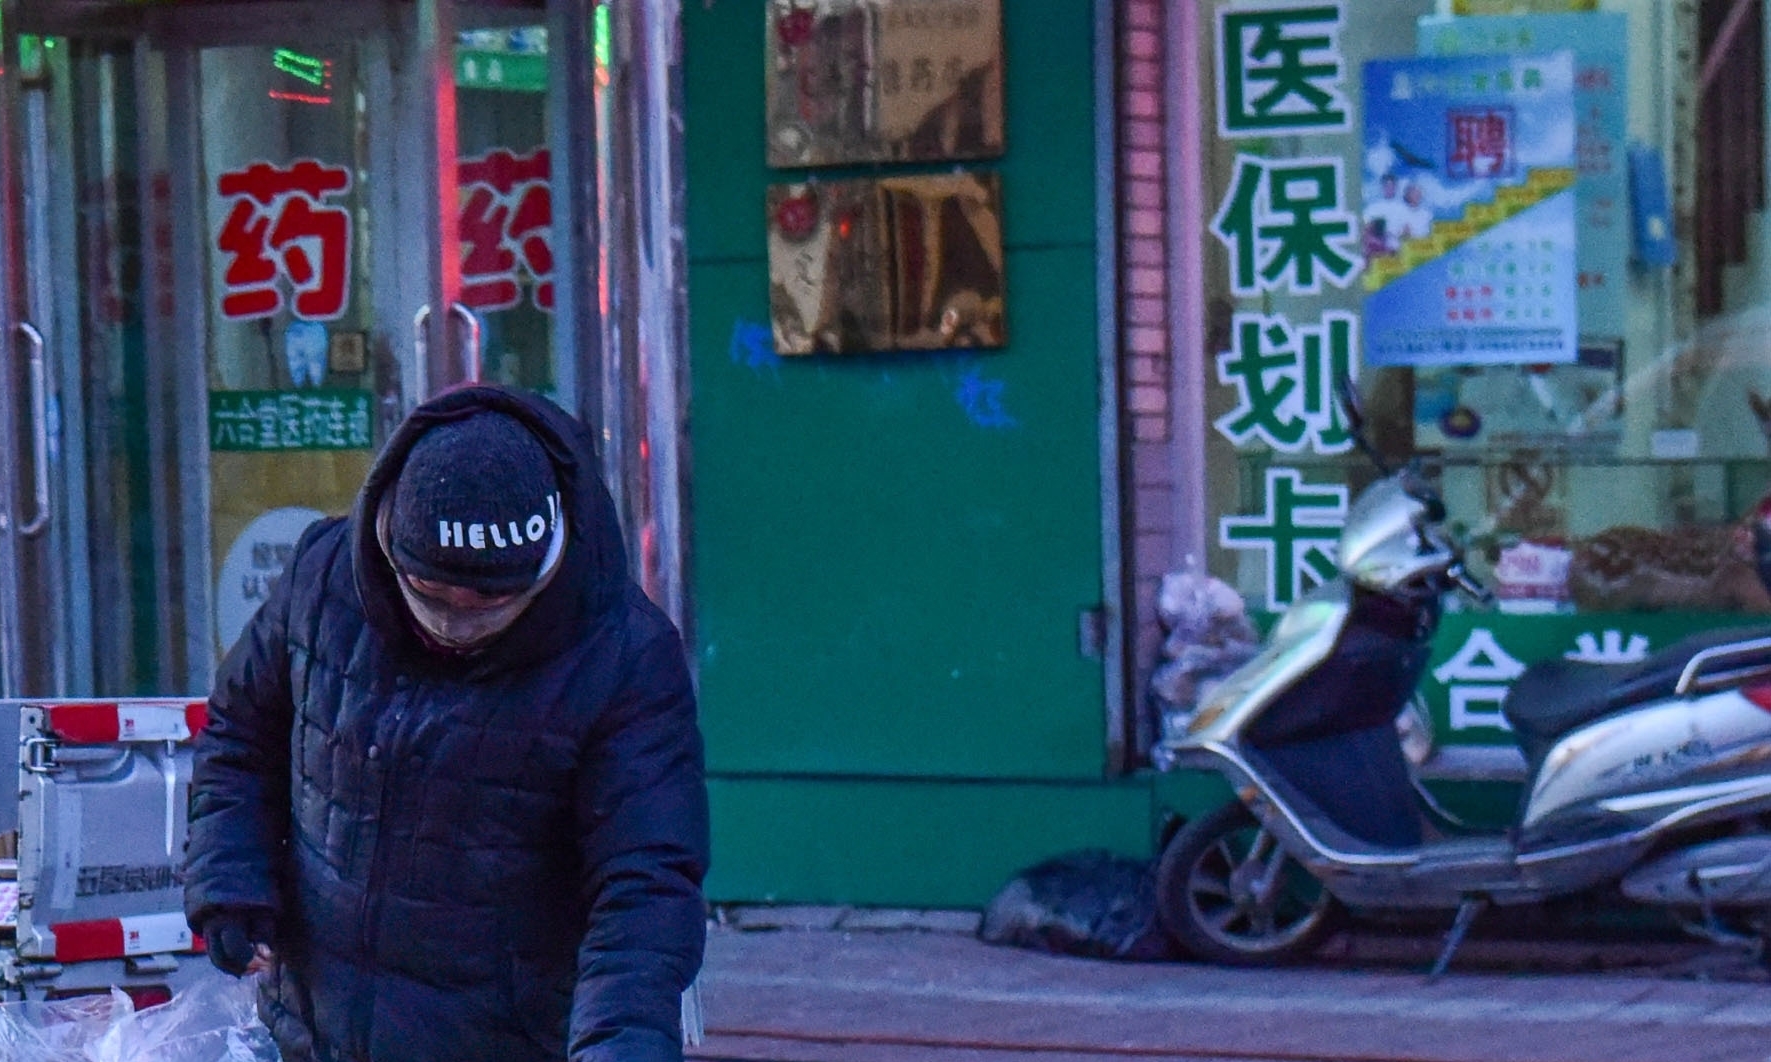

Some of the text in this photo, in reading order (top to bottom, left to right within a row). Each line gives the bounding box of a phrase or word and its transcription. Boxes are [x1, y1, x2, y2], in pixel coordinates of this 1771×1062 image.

[216, 158, 350, 318] 药
[1216, 3, 1362, 613] 医保划卡
